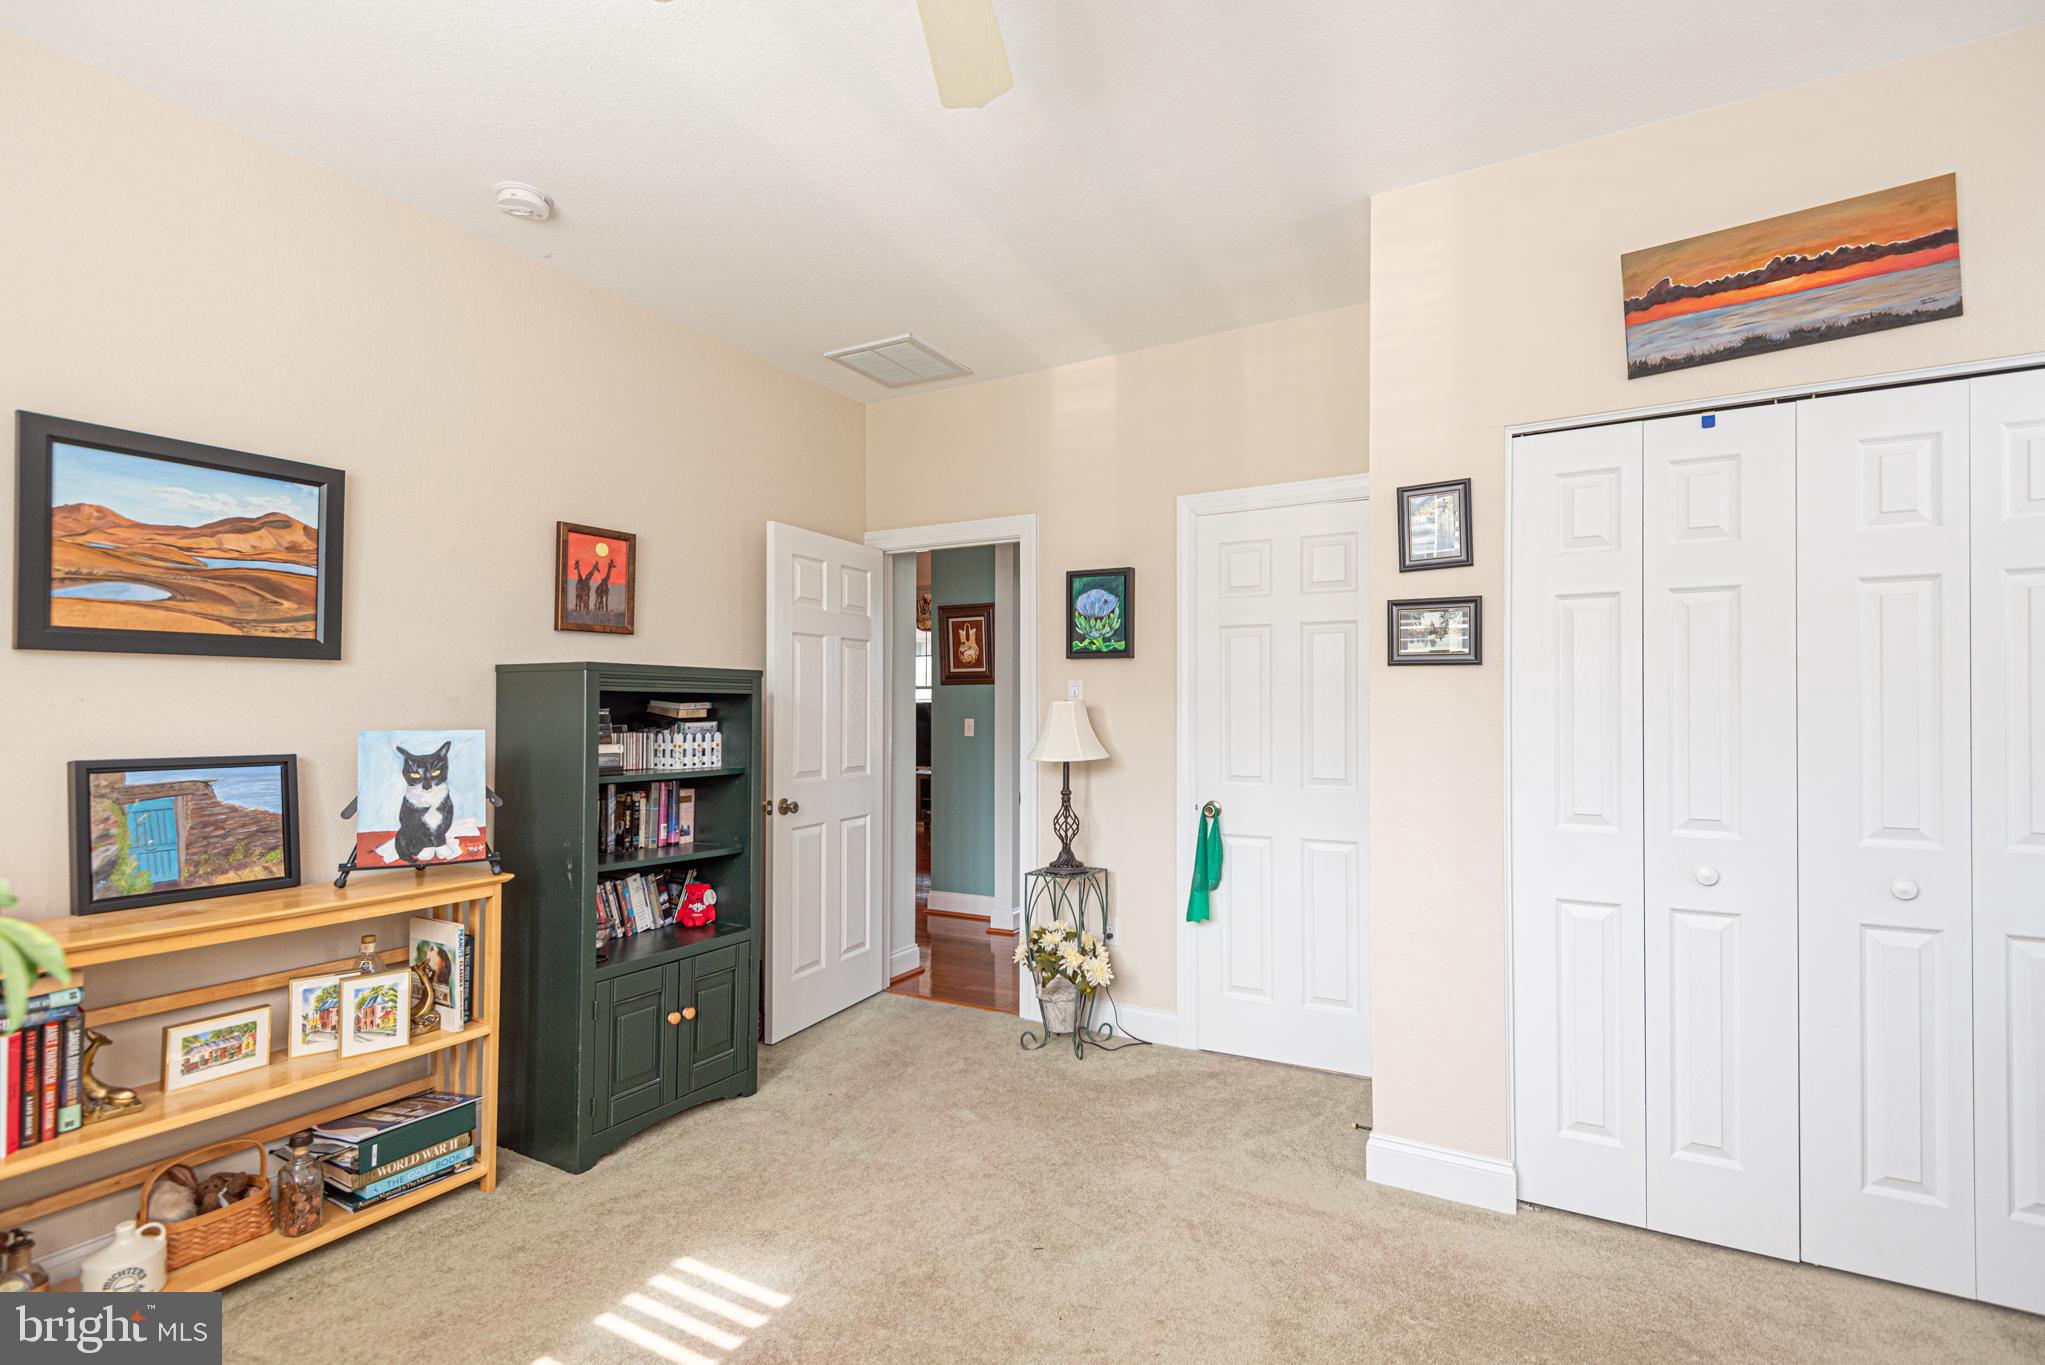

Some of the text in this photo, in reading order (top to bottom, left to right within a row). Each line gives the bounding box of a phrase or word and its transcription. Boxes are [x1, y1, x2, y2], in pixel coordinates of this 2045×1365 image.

[46, 1025, 59, 1044] JANET
[44, 1046, 59, 1084] EVANOVICH
[65, 1029, 81, 1081] SANDRA BROWN
[376, 1154, 420, 1177] WORLD
[422, 1143, 447, 1160] WAR
[450, 1138, 458, 1150] II
[387, 1176, 405, 1189] THE
[407, 1165, 433, 1180] GOLF
[435, 1154, 461, 1169] BOOK
